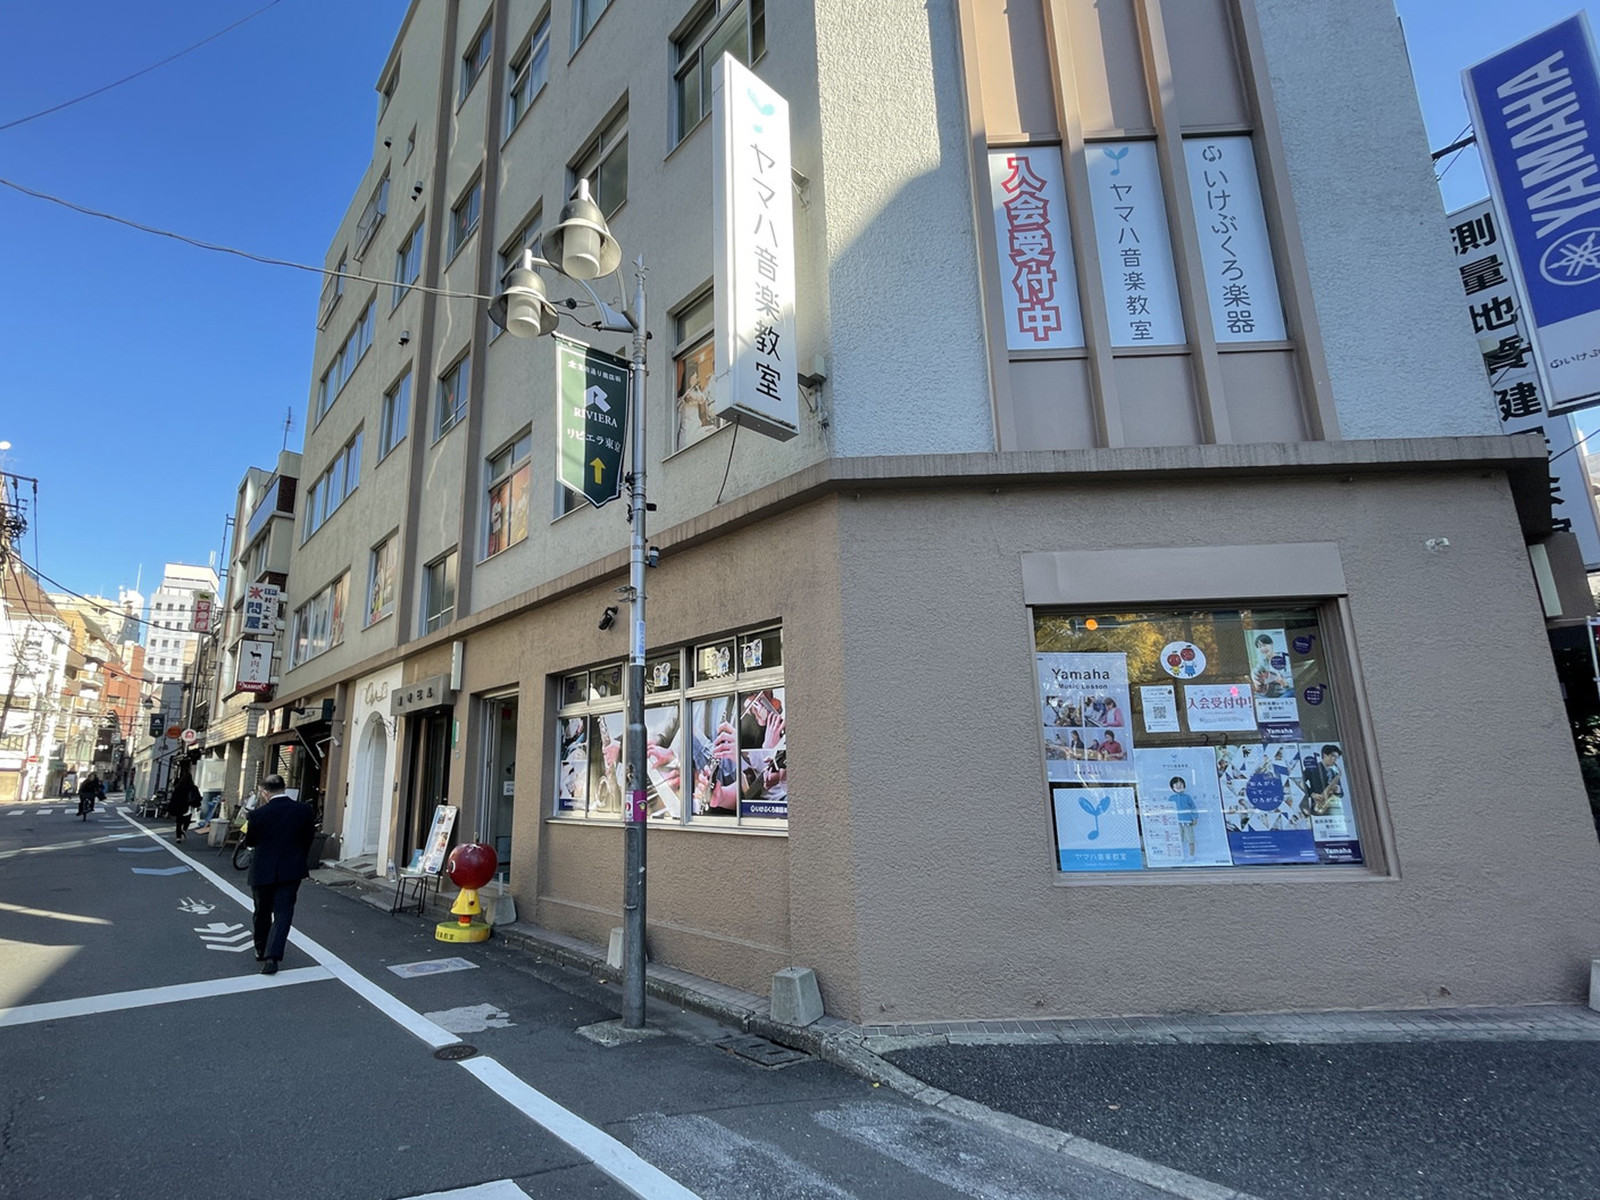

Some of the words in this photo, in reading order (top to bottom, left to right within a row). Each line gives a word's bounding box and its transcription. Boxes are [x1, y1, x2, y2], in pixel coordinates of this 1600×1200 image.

[1497, 50, 1600, 240] YAMAHA
[750, 143, 782, 402] ヤマハ音楽教室
[1001, 156, 1062, 342] 入会受付中
[1110, 184, 1153, 341] ヤマハ音楽教室
[1203, 170, 1256, 334] いけぶくろ楽器
[567, 428, 622, 453] リビエラ東京
[573, 407, 618, 428] RIVIERA
[1052, 668, 1110, 680] Yamaha
[1187, 697, 1252, 710] 入会受付中!
